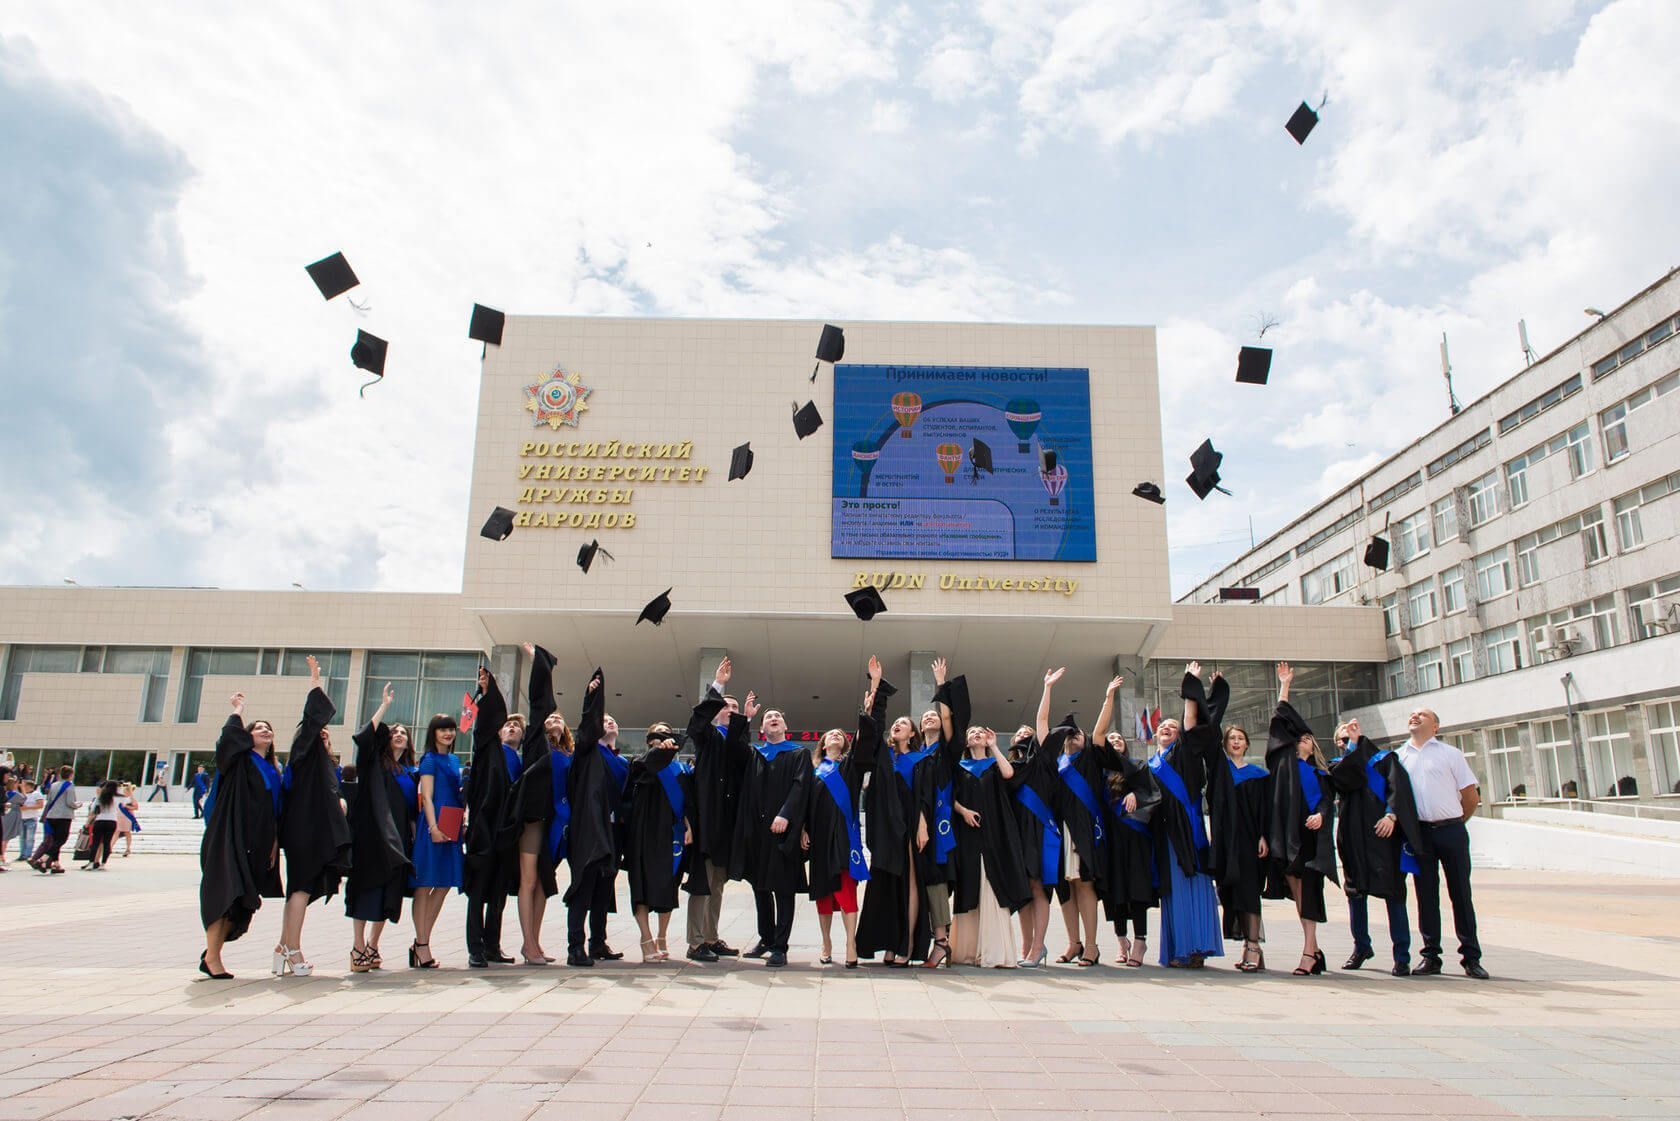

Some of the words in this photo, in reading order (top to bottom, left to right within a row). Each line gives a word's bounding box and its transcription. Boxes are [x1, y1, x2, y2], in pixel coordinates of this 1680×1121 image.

[886, 367, 976, 382] Принимаем
[982, 369, 1048, 382] новости!
[519, 439, 694, 459] РОССИЙСКИЙ
[518, 464, 708, 482] УНИВЕРСИТЕТ
[518, 487, 634, 504] ДРУЖБЫ
[841, 500, 860, 509] Это
[863, 501, 900, 511] просто!
[513, 511, 637, 529] НАРОДОВ
[852, 571, 928, 589] RUDN
[939, 573, 1079, 597] University
